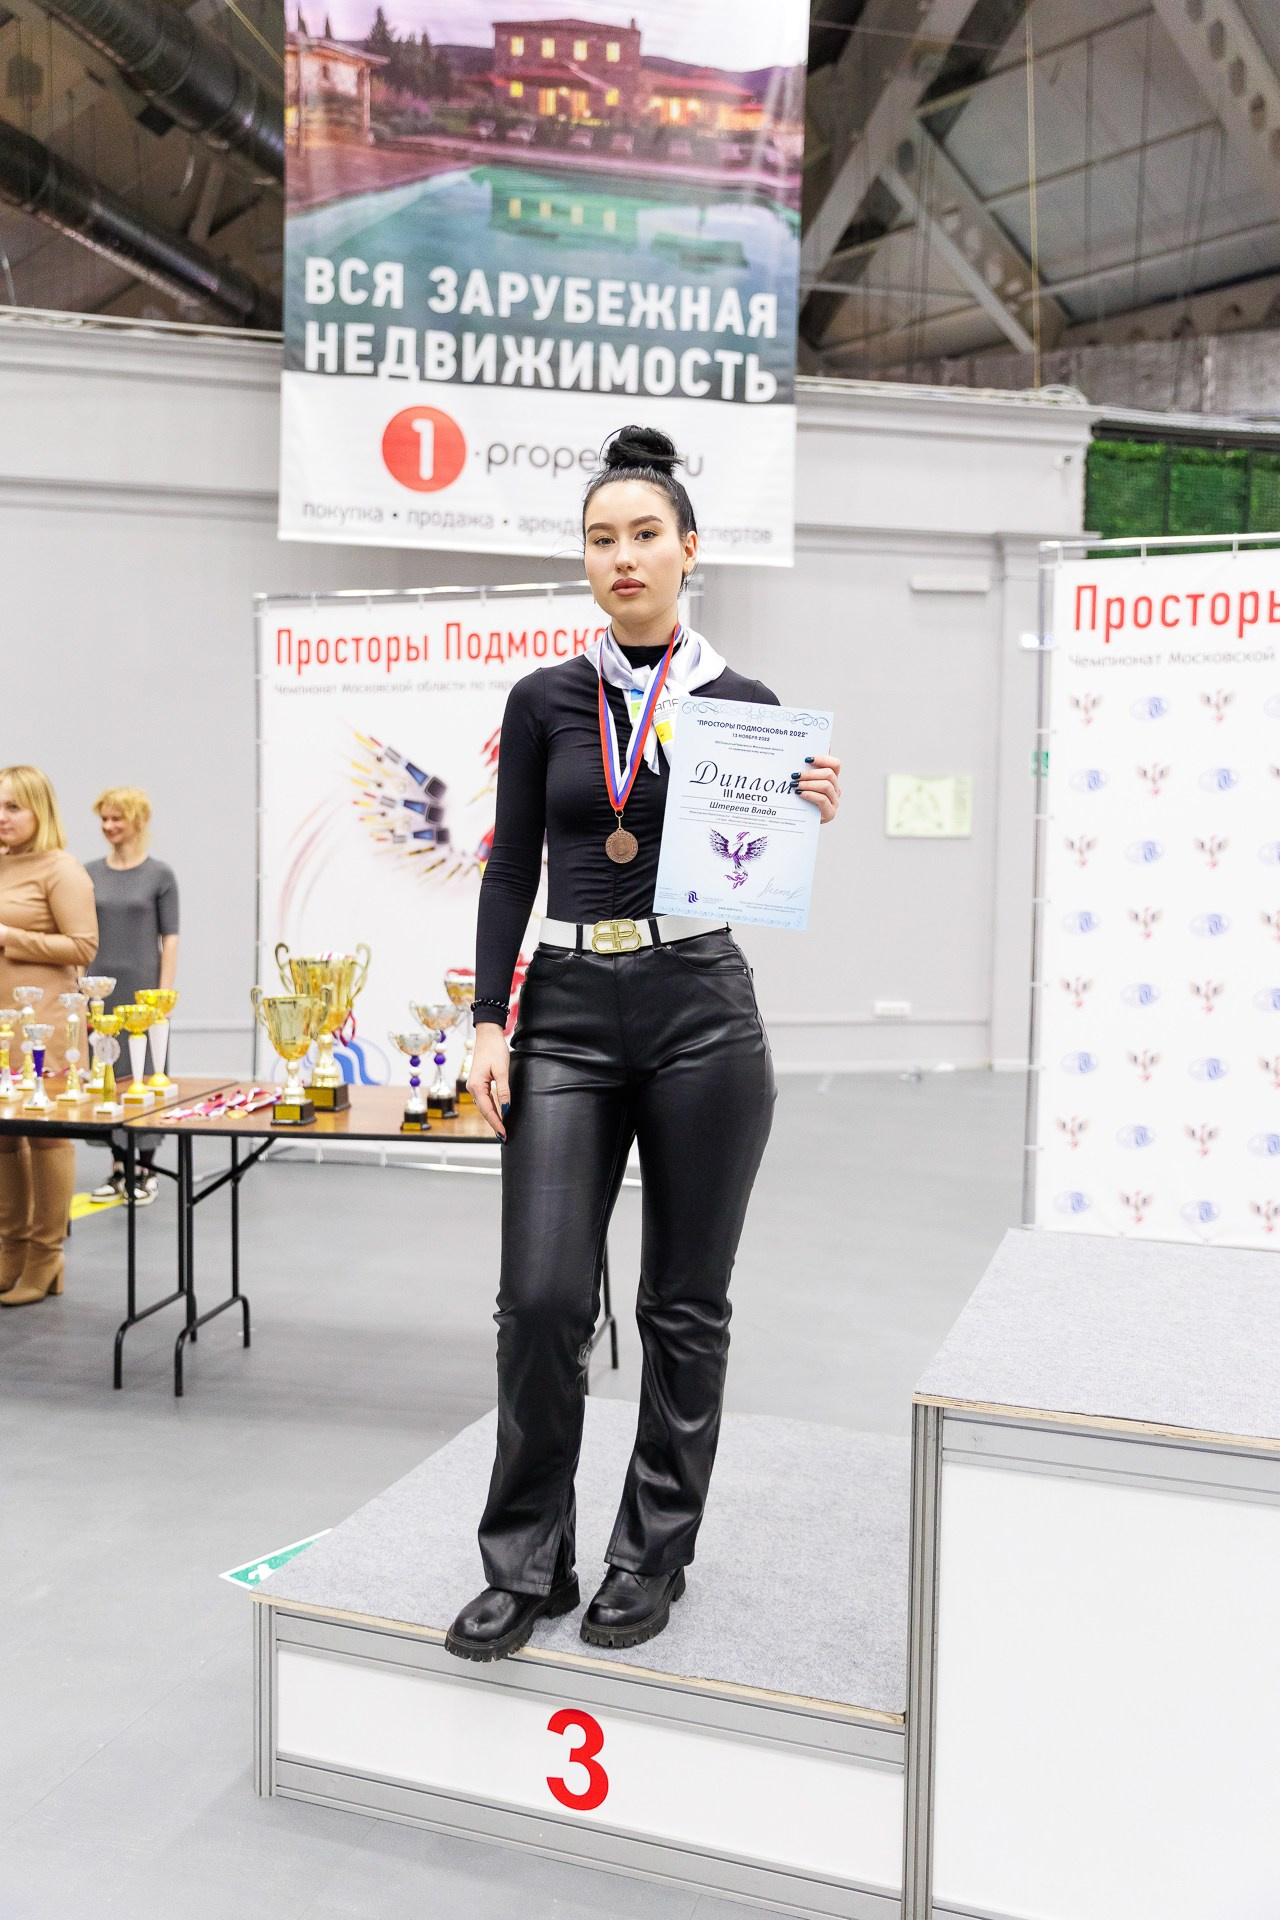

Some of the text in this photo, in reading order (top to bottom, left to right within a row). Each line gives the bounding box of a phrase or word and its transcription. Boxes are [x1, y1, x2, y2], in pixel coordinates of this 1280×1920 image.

[305, 257, 778, 338] ВСЯ ЗАРУБЕЖНАЯ
[304, 320, 778, 403] НЕДВИЖИМОСТЬ
[411, 418, 435, 481] 1
[302, 501, 384, 526] покупка
[407, 508, 494, 530] продажа
[276, 628, 429, 675] Просторы
[1168, 646, 1276, 665] Московской
[342, 679, 413, 695] Московской
[736, 723, 788, 736] ПОДМОСКОВЬЯ
[738, 733, 758, 741] НОЯБРЯ
[689, 760, 794, 795] Диплом
[709, 801, 750, 813] Штерева
[751, 806, 777, 816] Влада
[735, 791, 768, 803] место
[546, 1708, 609, 1811] 3
